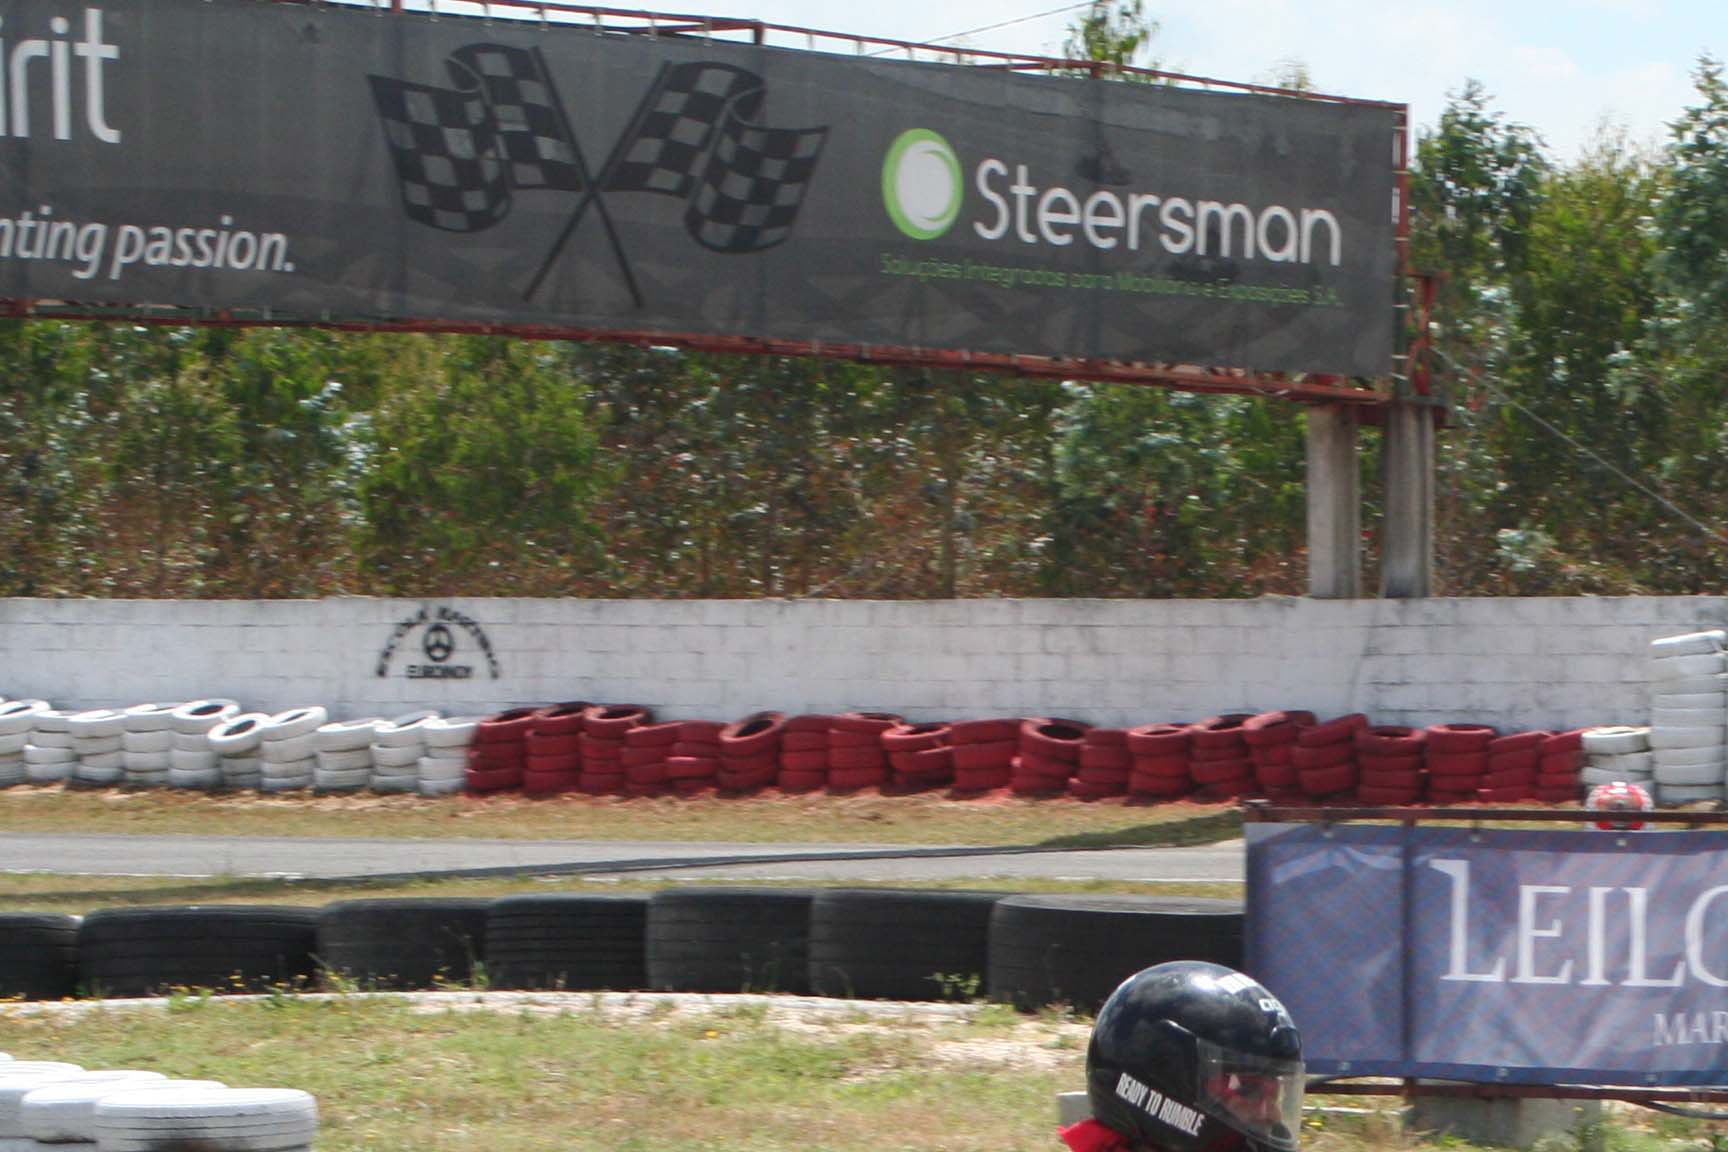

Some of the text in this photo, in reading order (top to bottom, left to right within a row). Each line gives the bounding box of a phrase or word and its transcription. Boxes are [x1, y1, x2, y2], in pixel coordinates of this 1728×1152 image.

[972, 157, 1342, 266] Steersman
[109, 215, 296, 280] passion.
[1115, 1072, 1205, 1136] READY TO RUMBLE
